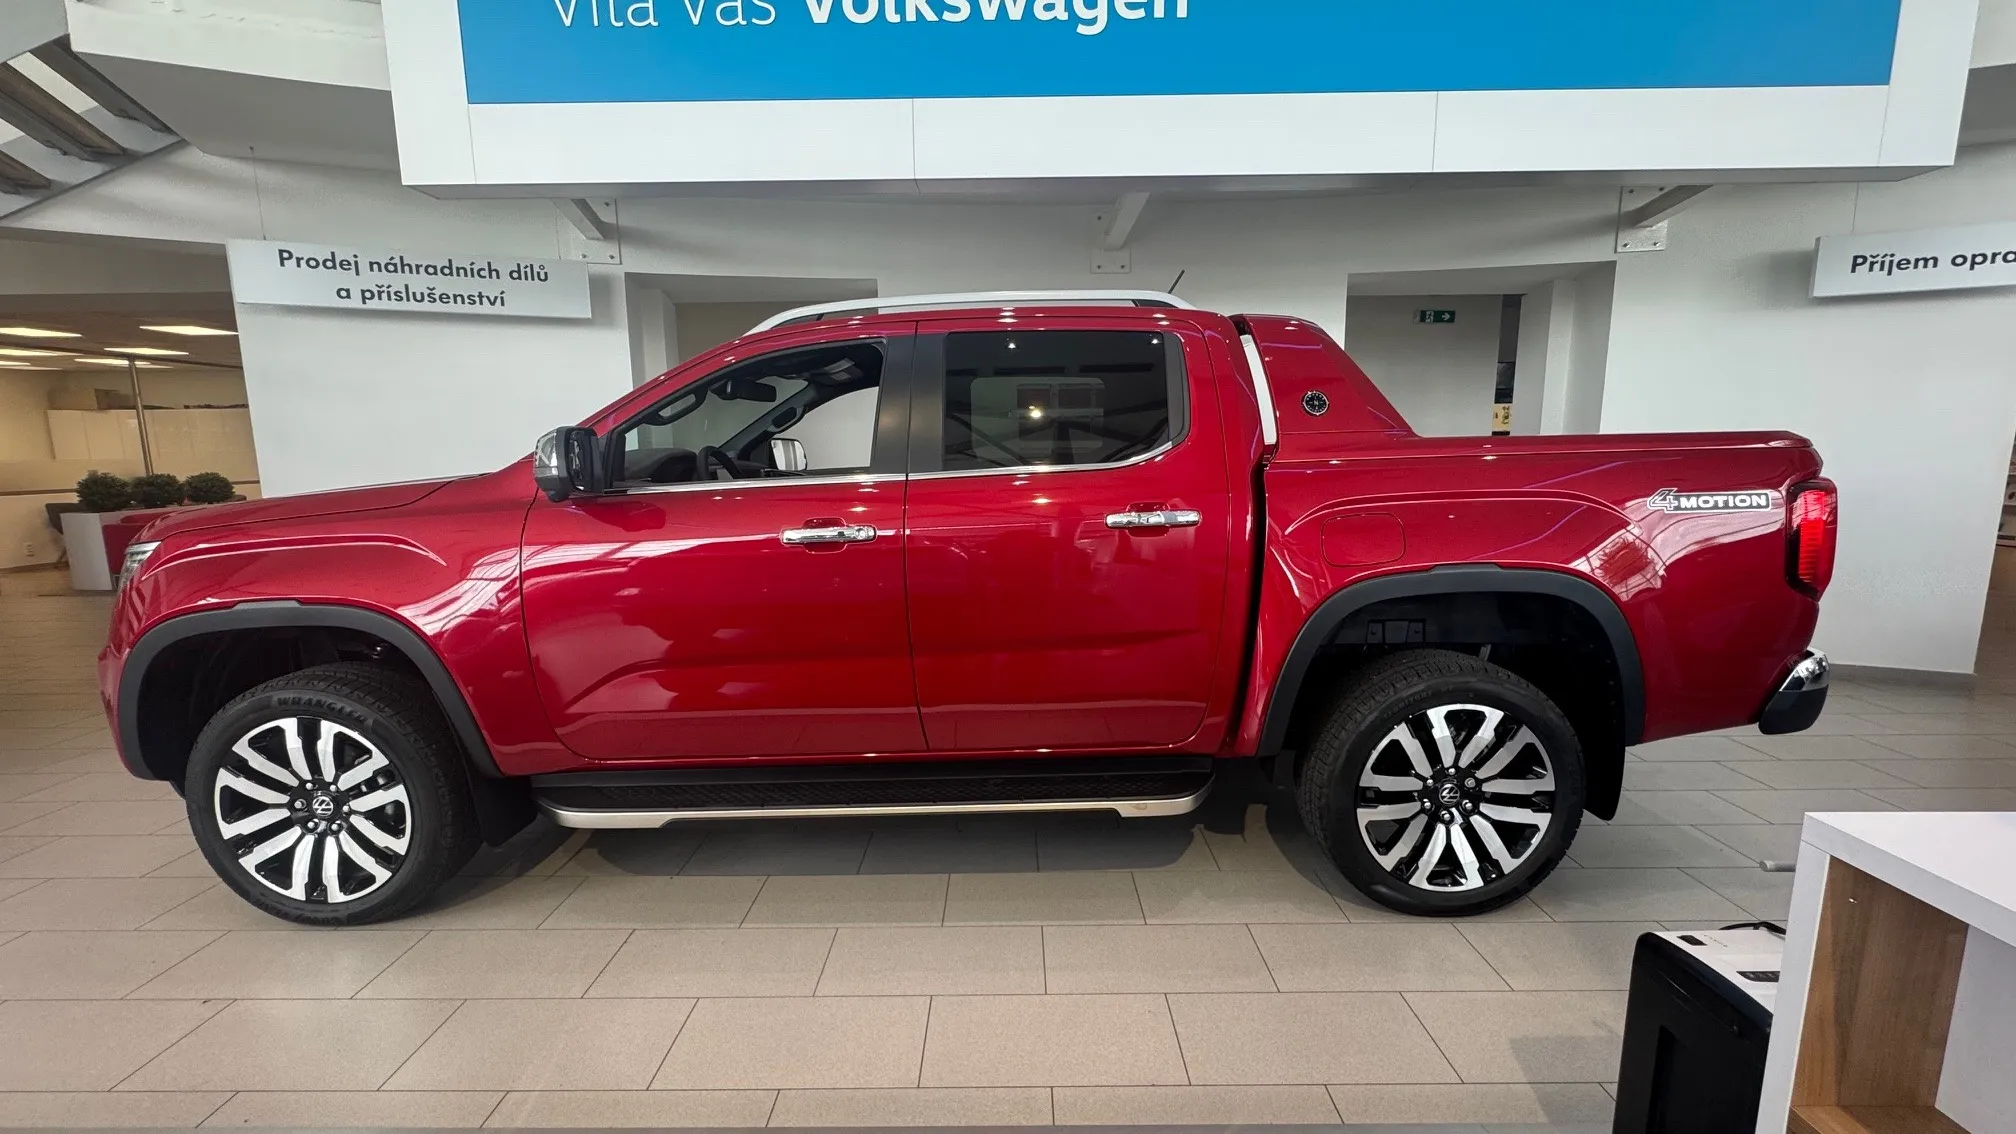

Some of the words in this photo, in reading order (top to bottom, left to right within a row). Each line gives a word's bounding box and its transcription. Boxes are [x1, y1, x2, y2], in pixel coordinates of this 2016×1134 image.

[277, 248, 360, 276] Prodej
[368, 255, 501, 280] náhradních
[508, 262, 549, 283] dílů
[1849, 253, 1939, 276] Příjem
[336, 287, 352, 300] a
[360, 283, 506, 307] příslušenství
[1647, 488, 1768, 512] 4MOTION
